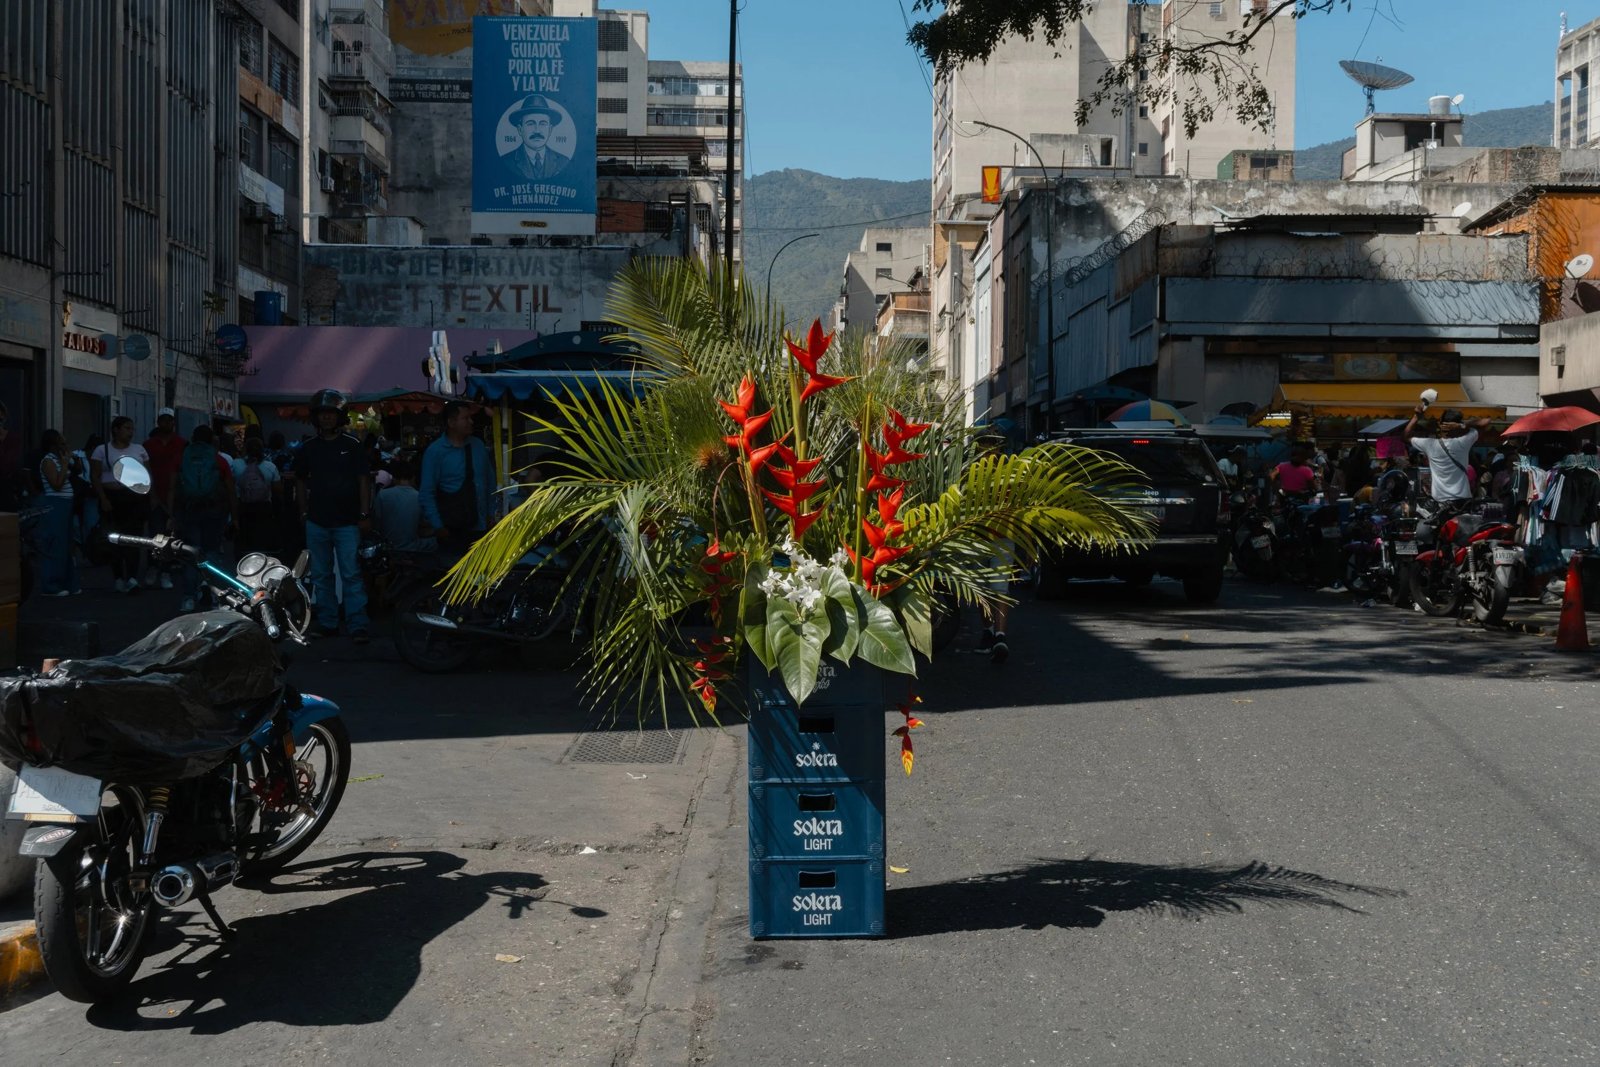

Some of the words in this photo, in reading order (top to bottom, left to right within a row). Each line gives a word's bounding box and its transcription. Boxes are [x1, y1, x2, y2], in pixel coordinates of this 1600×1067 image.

[502, 24, 570, 41] VENEZUELA
[511, 42, 561, 58] GUIADOS
[508, 59, 533, 75] POR
[535, 60, 549, 75] LA
[551, 60, 565, 75] FE
[512, 76, 520, 91] Y
[522, 76, 536, 91] LA
[539, 76, 560, 92] PAZ
[493, 188, 510, 198] DR.
[511, 183, 531, 195] JOSÉ
[533, 184, 577, 198] GREGORIO
[511, 193, 559, 206] HERNÁNDEZ
[407, 254, 565, 277] DEPORTIVAS
[438, 283, 563, 314] TEXTIL
[795, 751, 838, 768] solera
[793, 817, 843, 836] solera
[804, 838, 833, 851] LIGHT
[792, 892, 843, 912] solera
[803, 913, 832, 926] LIGHT
